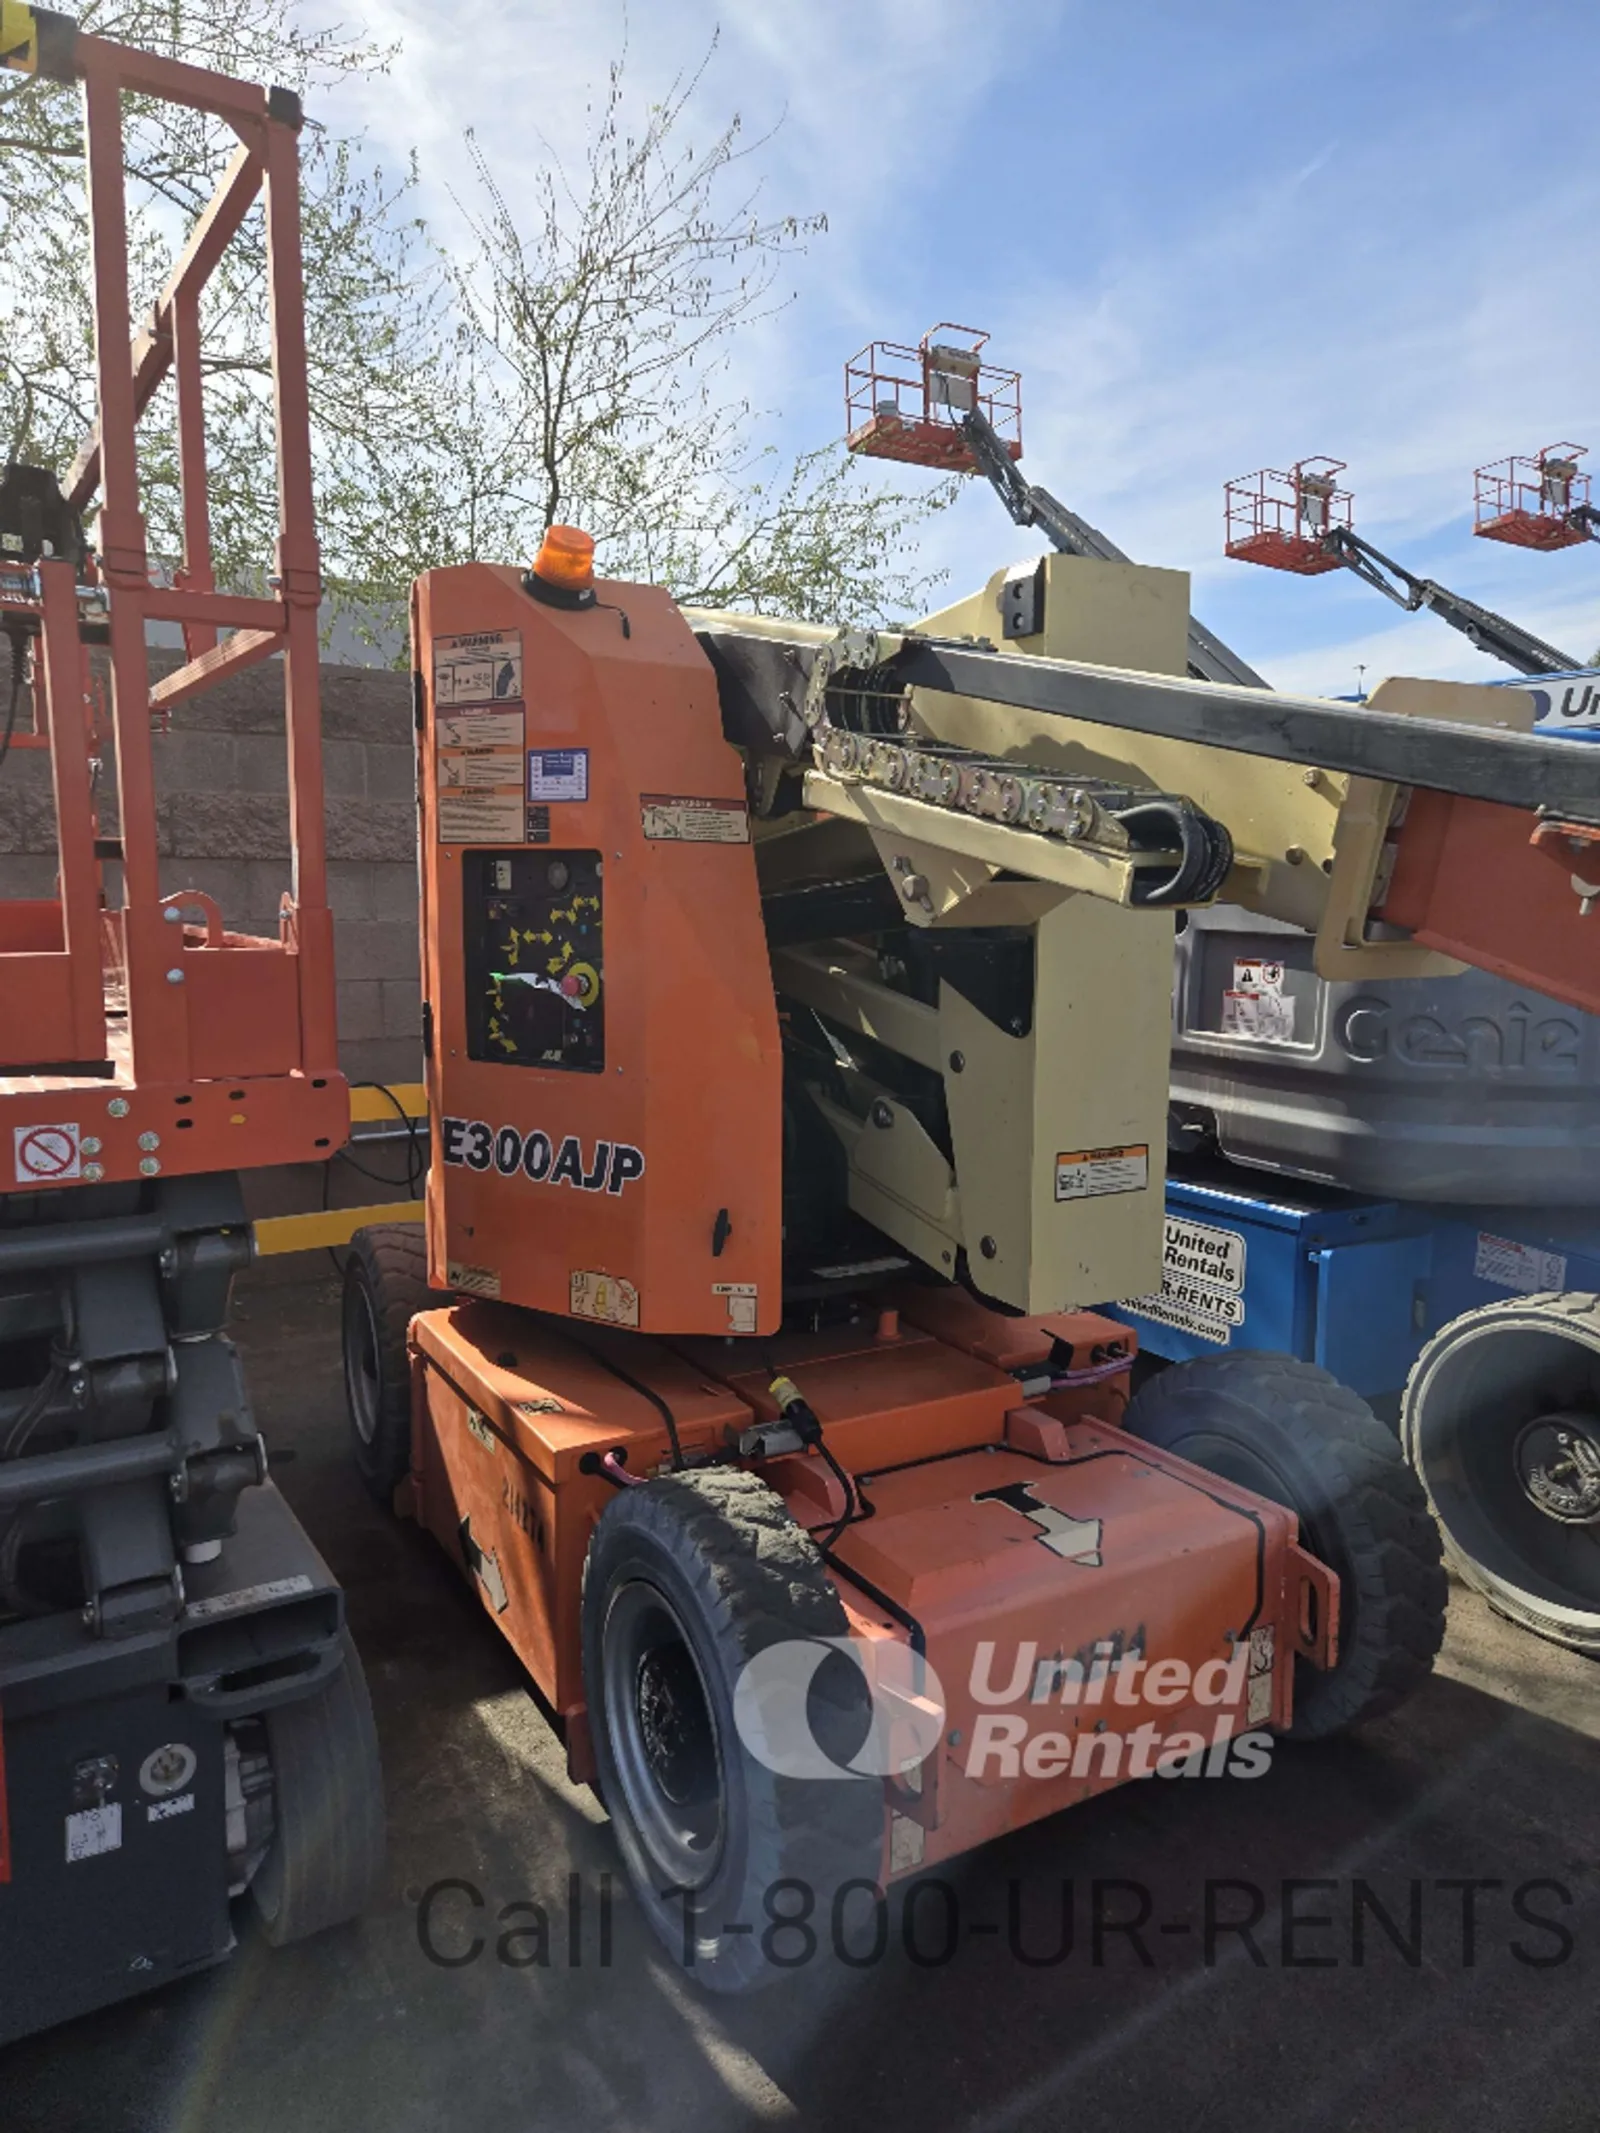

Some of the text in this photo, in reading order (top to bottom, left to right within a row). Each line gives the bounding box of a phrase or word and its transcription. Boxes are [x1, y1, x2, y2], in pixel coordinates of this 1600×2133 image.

[443, 1116, 645, 1196] E300AJP
[1165, 1225, 1231, 1260] United
[1164, 1246, 1235, 1282] Rentals
